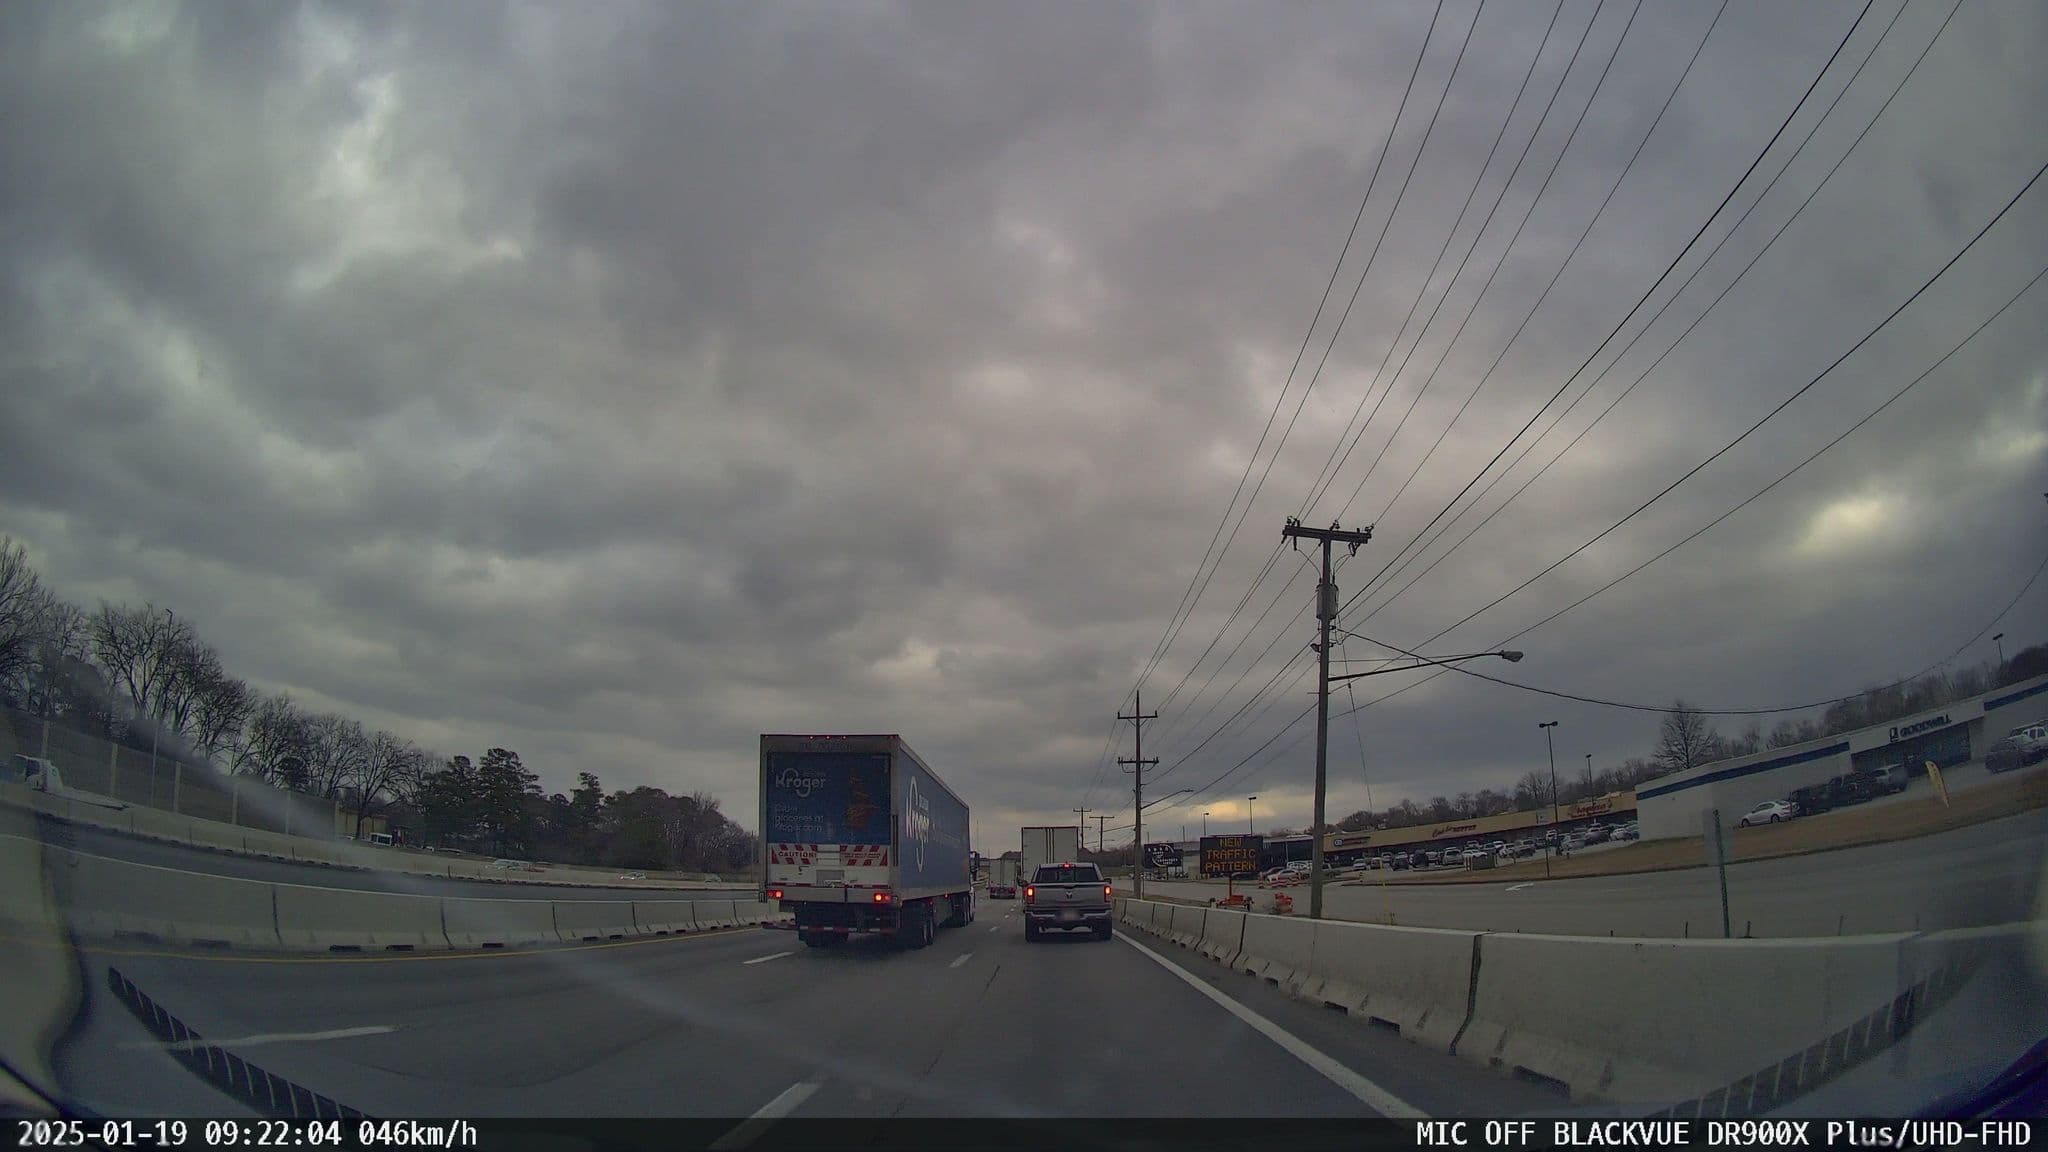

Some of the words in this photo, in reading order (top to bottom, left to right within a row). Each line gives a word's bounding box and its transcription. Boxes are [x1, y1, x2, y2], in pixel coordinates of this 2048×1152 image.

[775, 768, 827, 797] Kroger
[906, 776, 929, 872] Kroger
[1220, 837, 1242, 847] NEW
[1206, 849, 1256, 860] TRAFFIC
[1205, 861, 1256, 872] PATTERN
